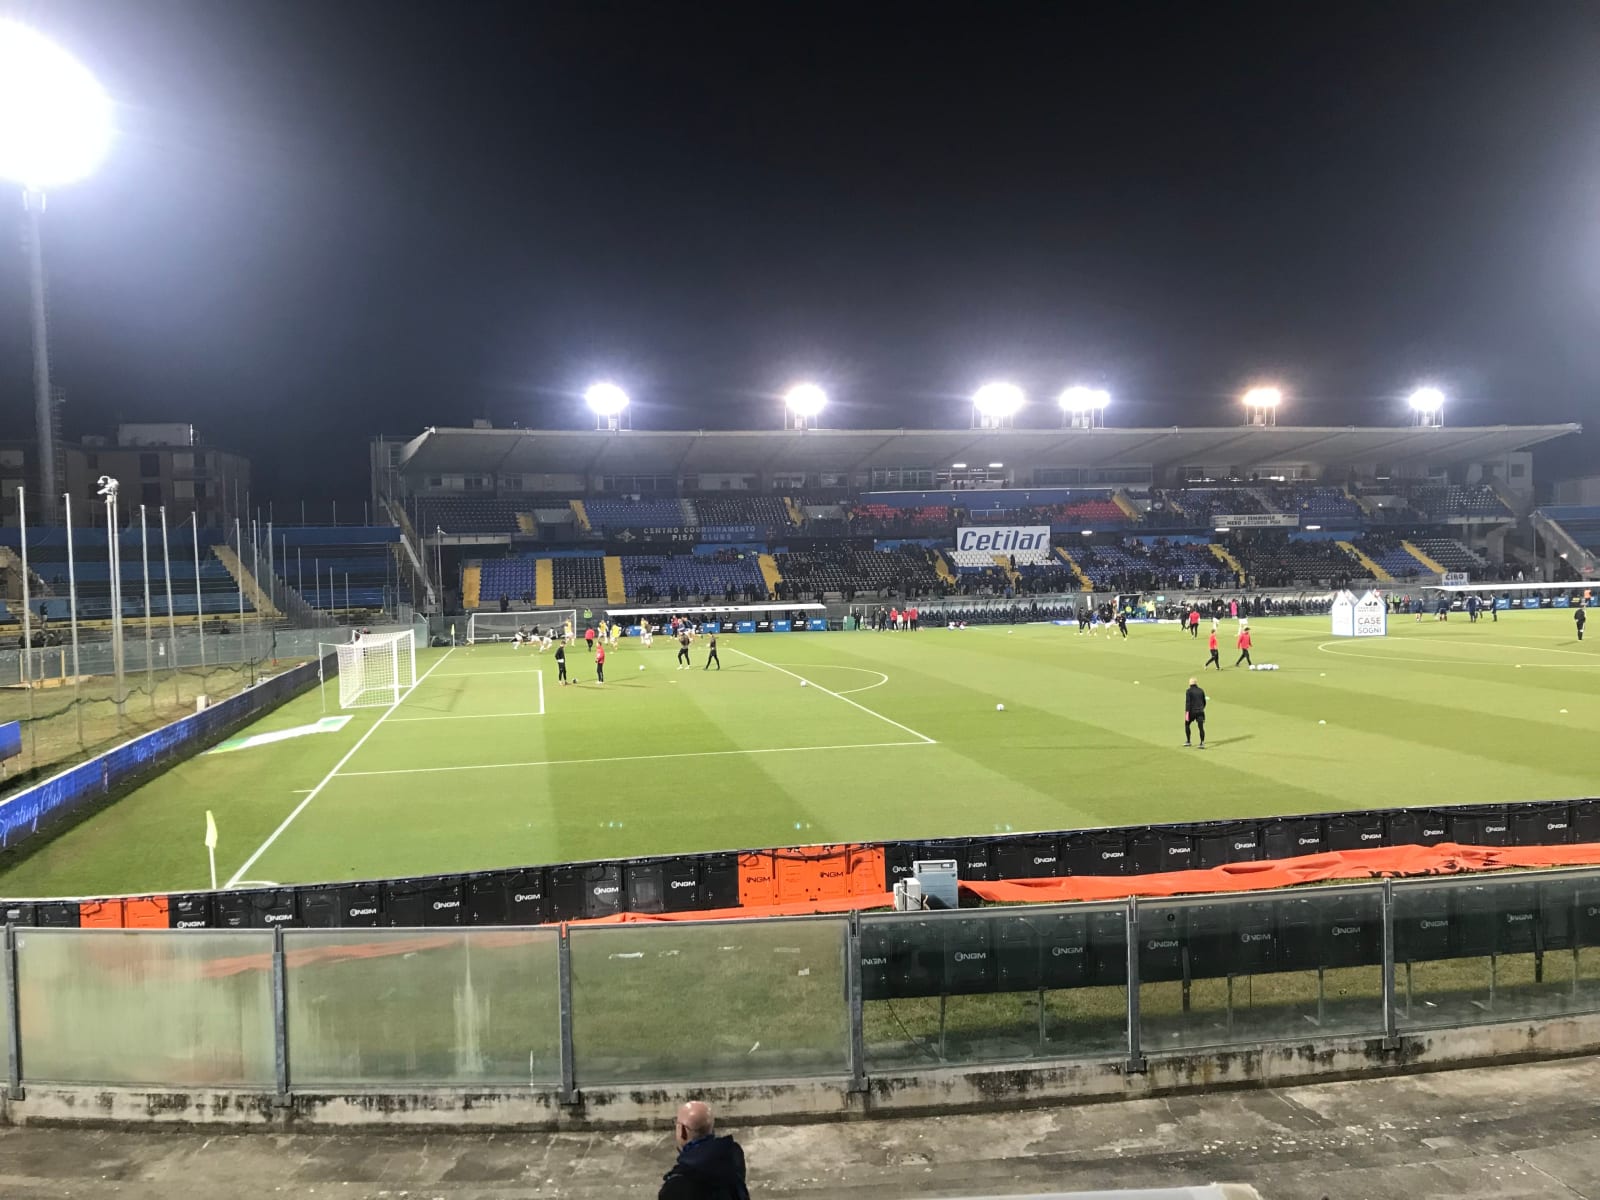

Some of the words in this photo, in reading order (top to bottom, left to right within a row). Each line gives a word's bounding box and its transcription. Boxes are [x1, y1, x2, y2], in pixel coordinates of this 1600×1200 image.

[683, 525, 756, 534] COORDINAMENTO
[960, 530, 1047, 551] Cetilar
[1358, 616, 1382, 625] CASE
